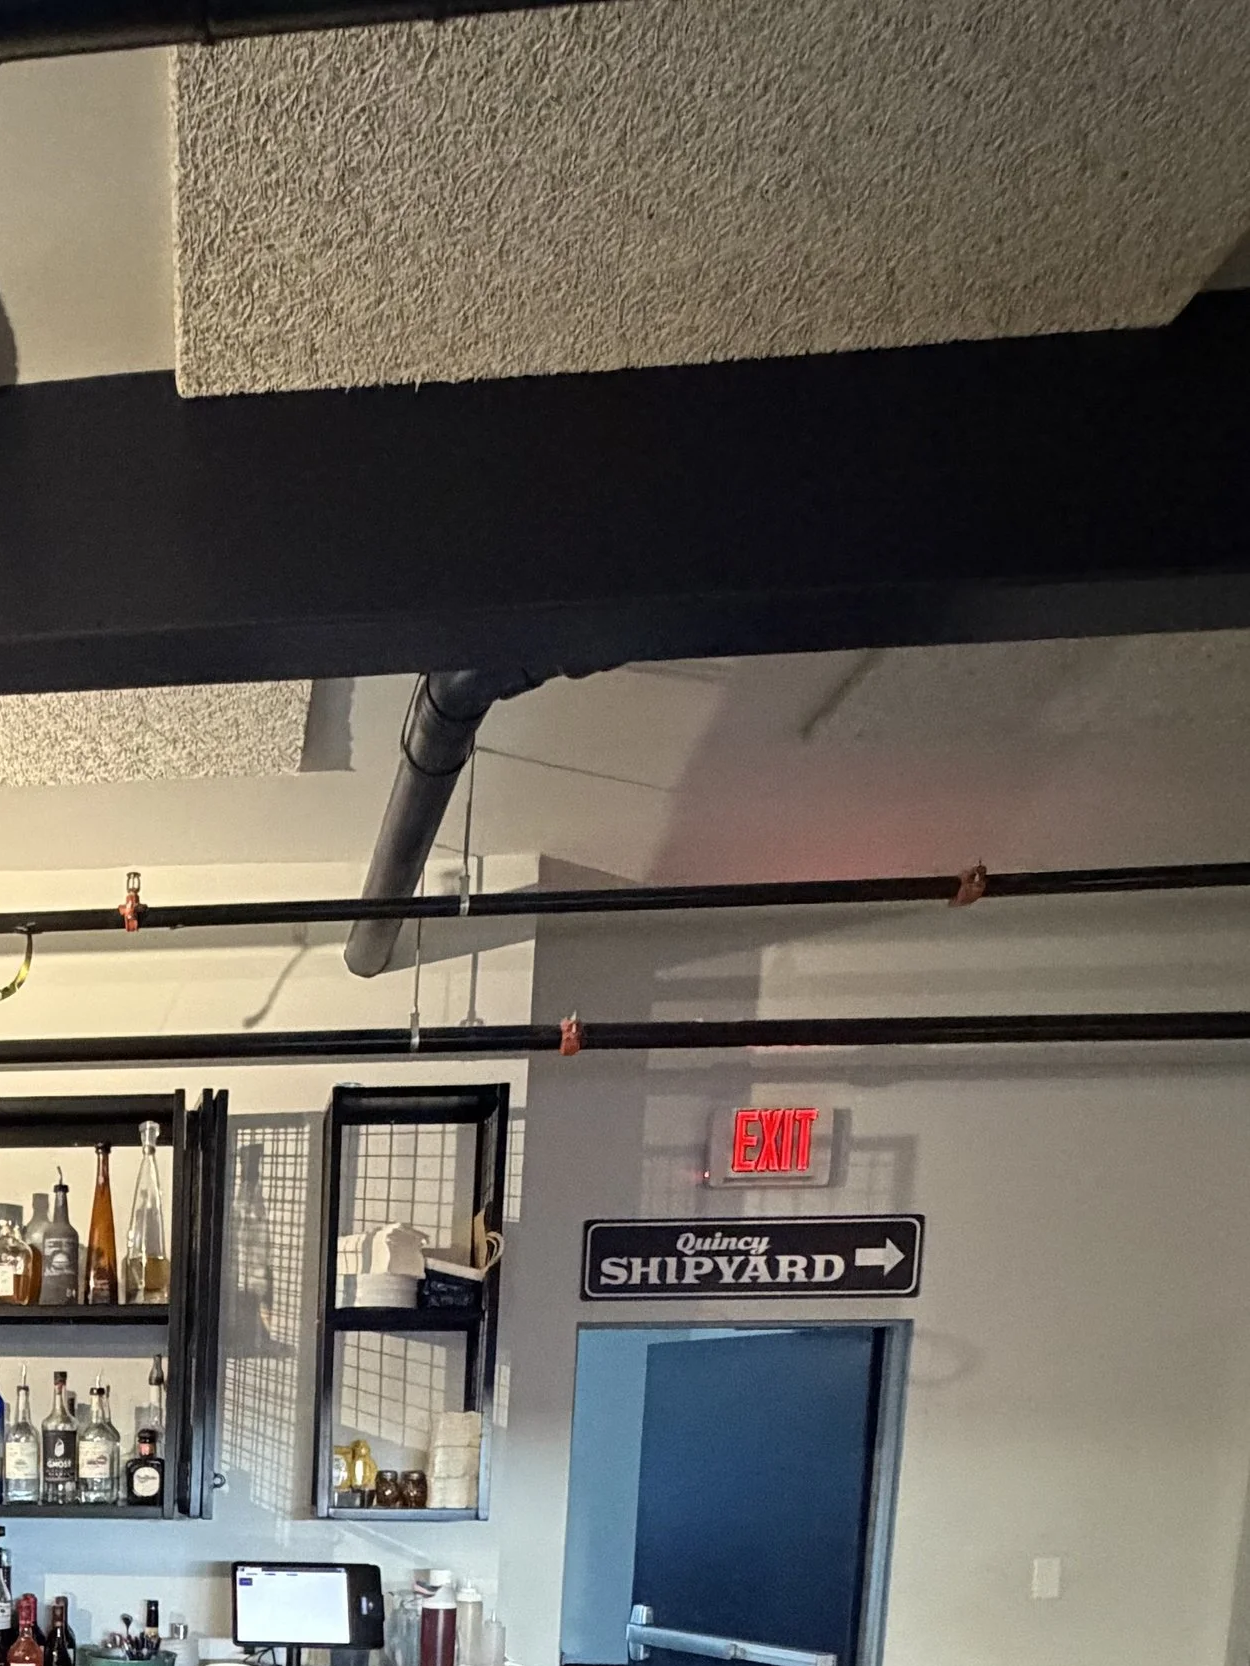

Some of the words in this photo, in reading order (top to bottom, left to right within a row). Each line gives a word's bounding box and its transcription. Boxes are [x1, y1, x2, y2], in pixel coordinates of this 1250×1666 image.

[733, 1109, 818, 1172] EXIT
[676, 1232, 772, 1255] Quincy
[600, 1254, 846, 1285] SHIPYARD
